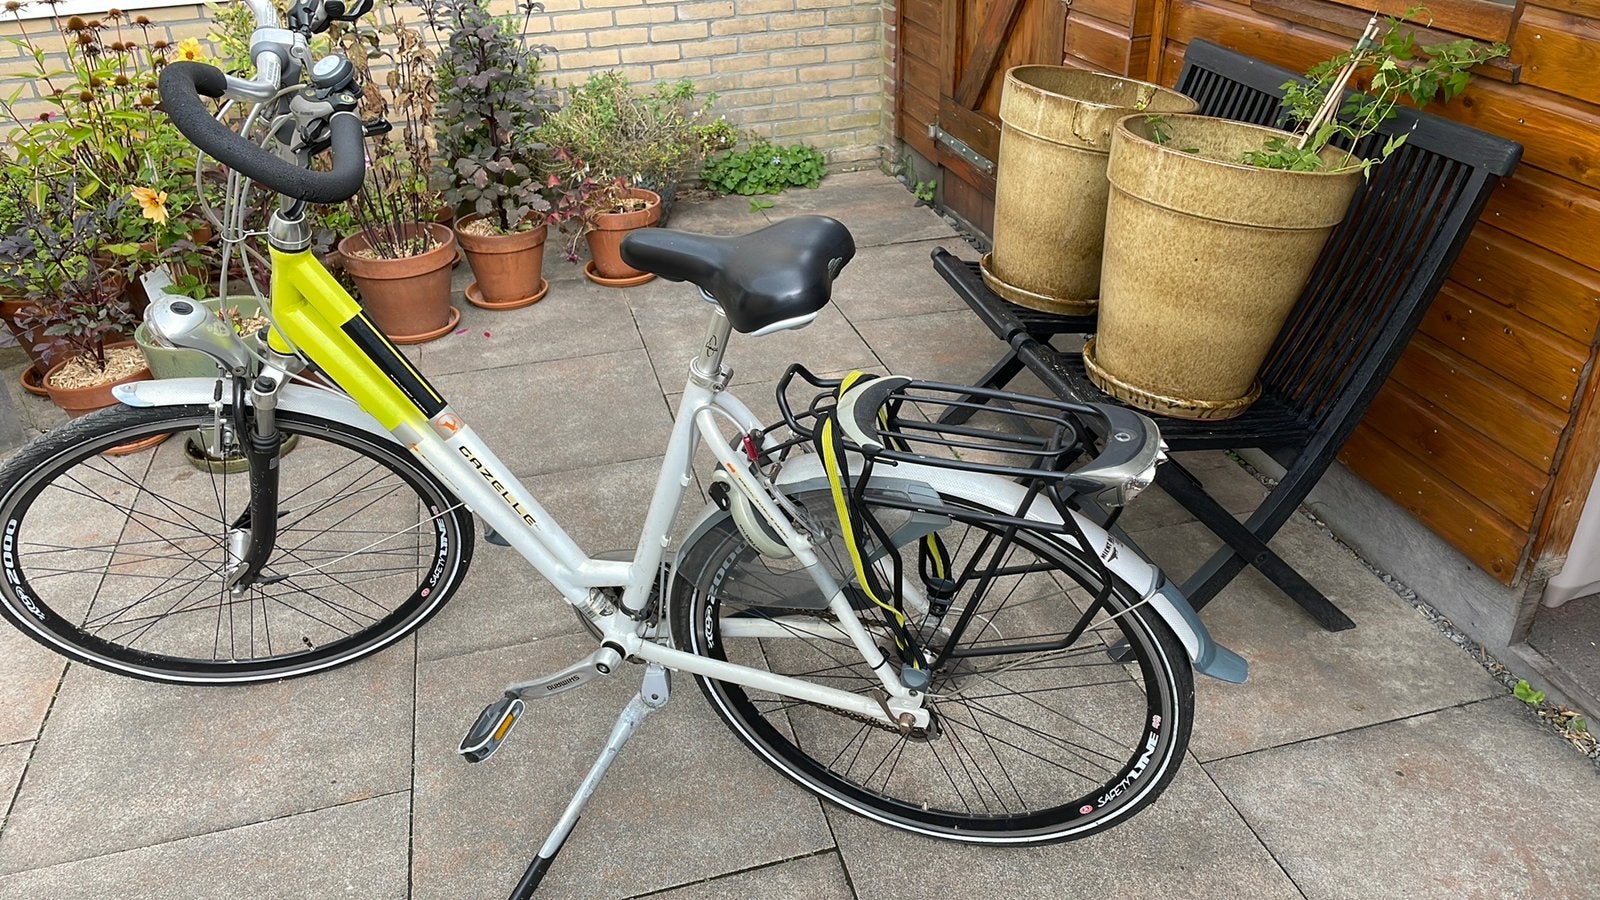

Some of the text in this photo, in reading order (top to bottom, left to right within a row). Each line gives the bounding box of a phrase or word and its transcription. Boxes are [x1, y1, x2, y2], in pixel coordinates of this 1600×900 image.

[458, 445, 537, 526] GAZELLE
[3, 519, 20, 585] 2000
[546, 674, 580, 691] SHIMANO
